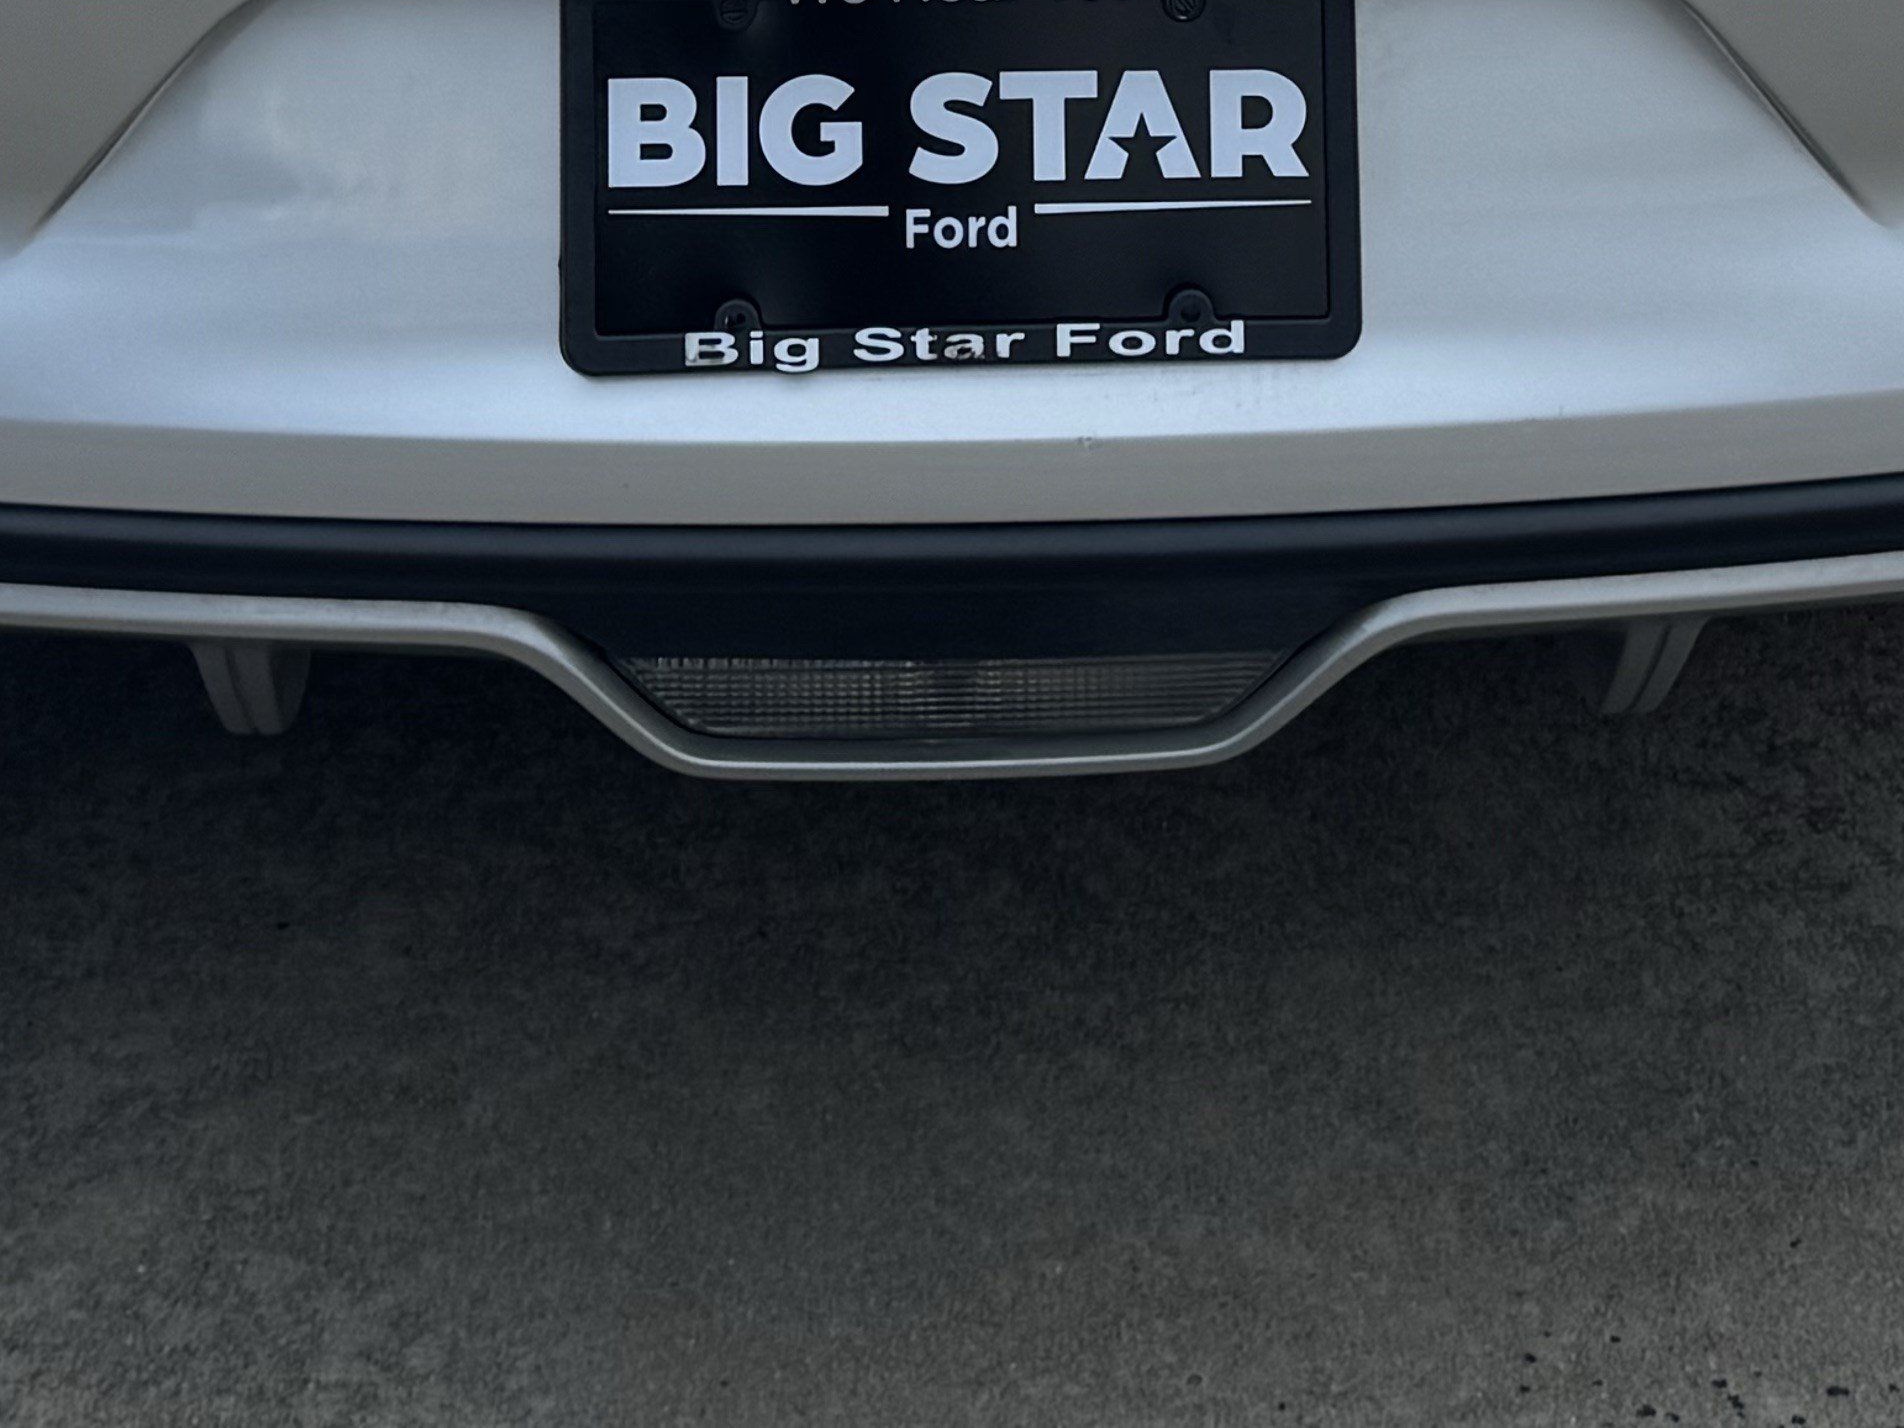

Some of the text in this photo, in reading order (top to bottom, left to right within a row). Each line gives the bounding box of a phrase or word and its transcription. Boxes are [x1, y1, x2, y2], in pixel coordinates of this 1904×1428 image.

[608, 69, 1311, 188] BIG STAR
[904, 204, 1019, 249] Ford
[683, 319, 1247, 372] Big Star Ford
